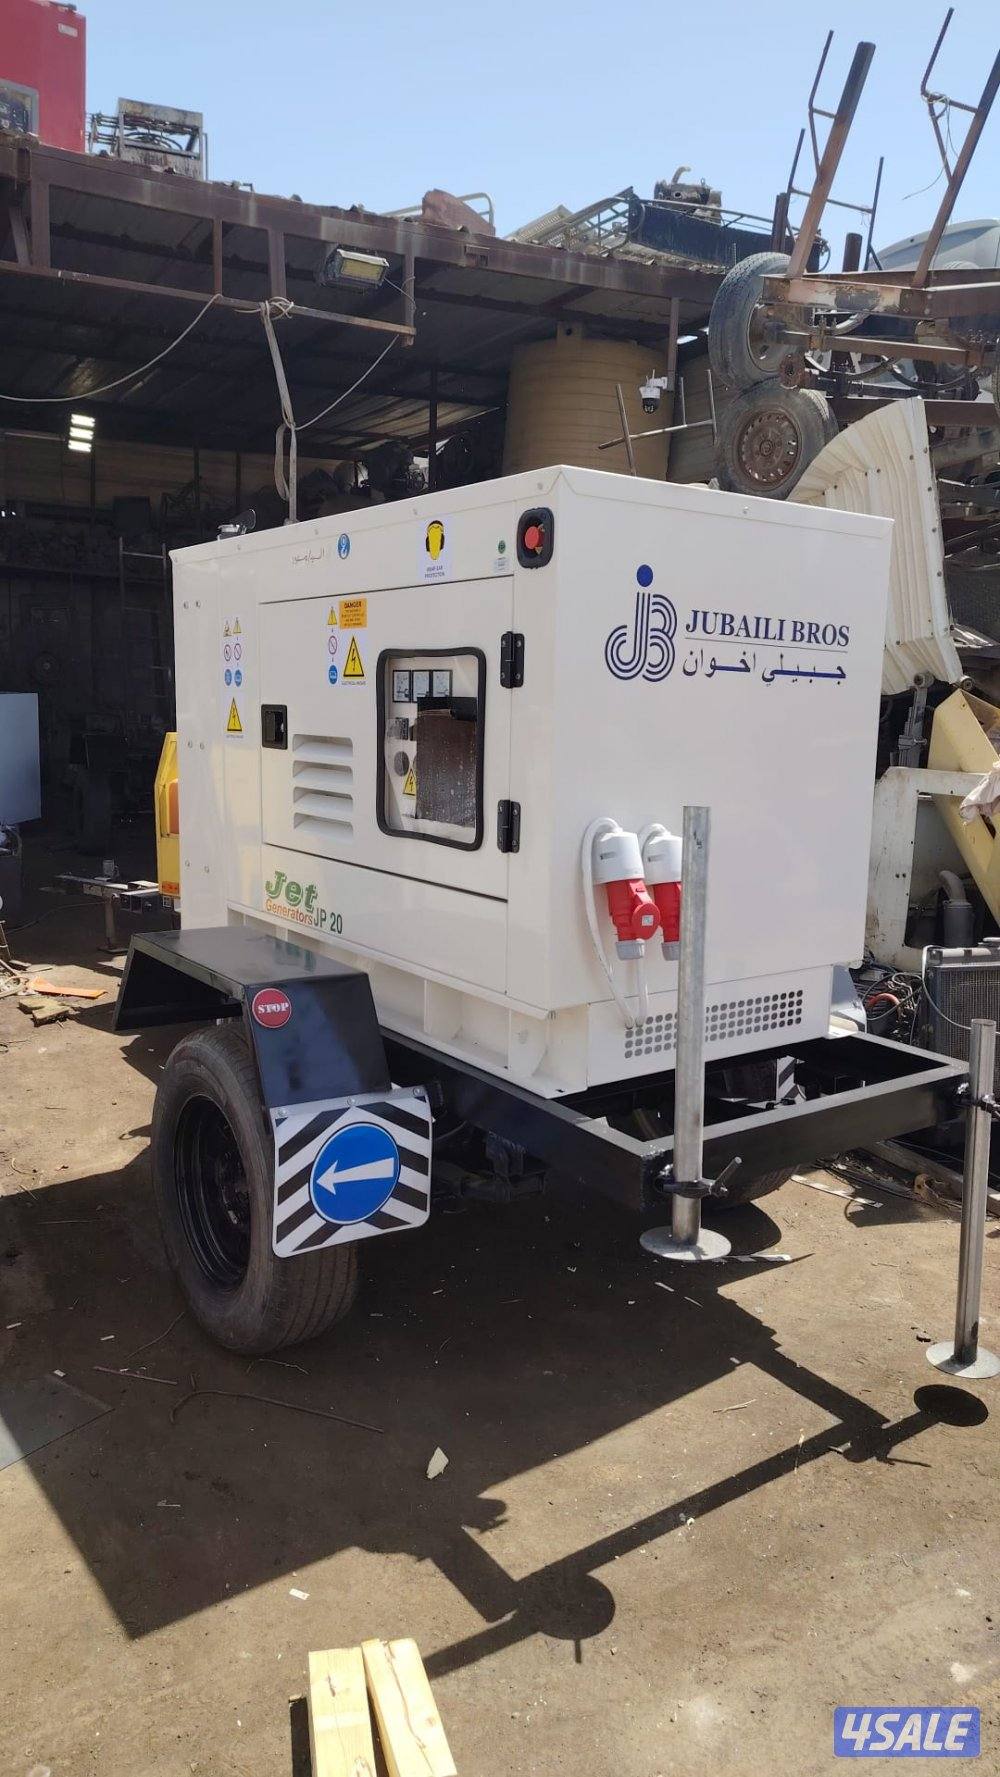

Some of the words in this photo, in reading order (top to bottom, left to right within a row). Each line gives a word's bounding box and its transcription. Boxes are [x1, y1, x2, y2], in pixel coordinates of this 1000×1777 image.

[685, 609, 786, 641] JUBAILI
[790, 620, 850, 647] BROS
[265, 870, 318, 914] Jet
[265, 898, 313, 926] Generators
[313, 907, 327, 928] JP
[330, 911, 343, 934] 20
[258, 1002, 289, 1014] STOP
